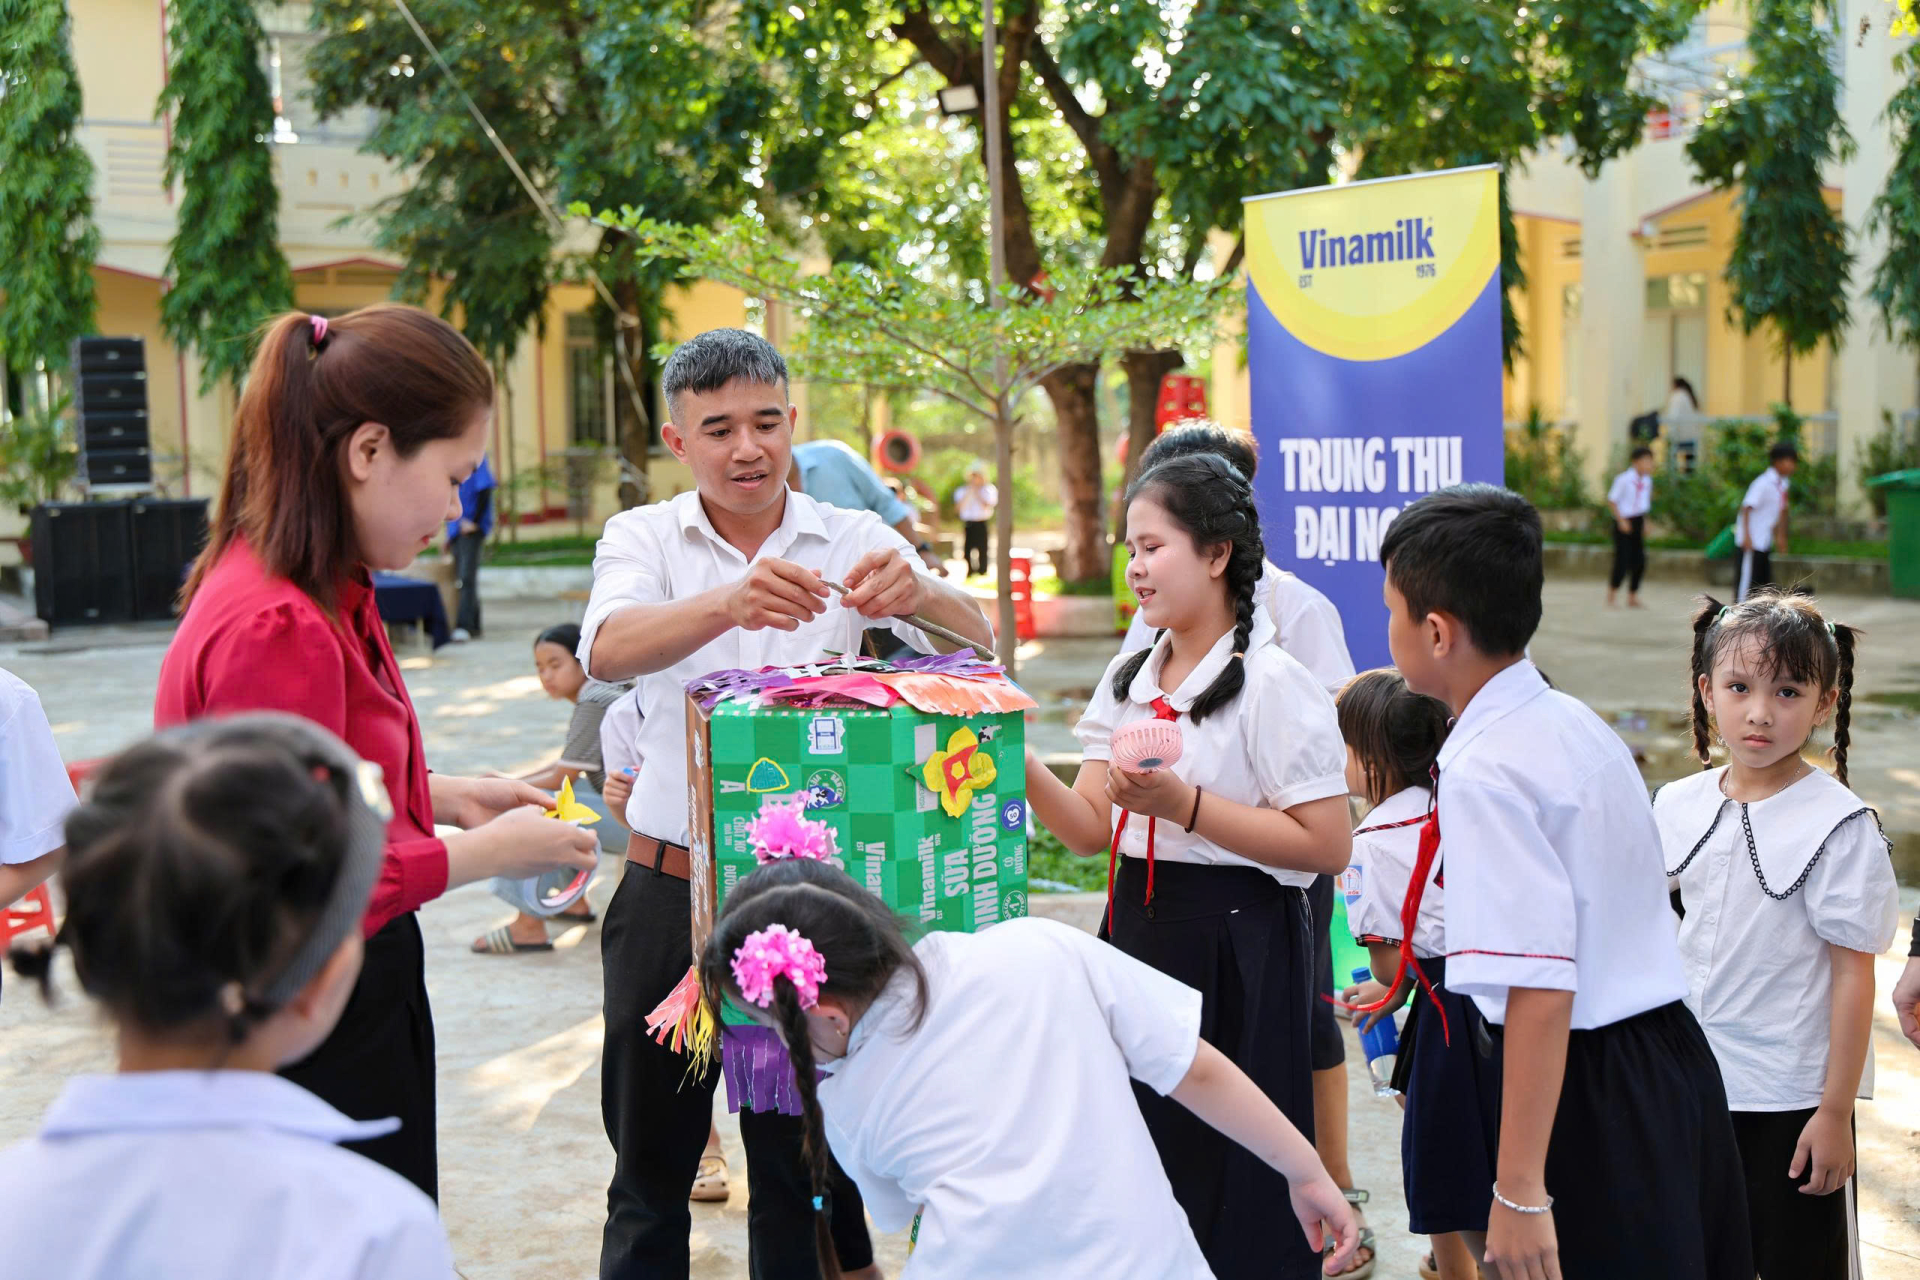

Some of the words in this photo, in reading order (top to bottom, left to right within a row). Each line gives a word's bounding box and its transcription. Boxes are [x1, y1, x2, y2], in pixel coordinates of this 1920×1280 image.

[1299, 217, 1435, 270] Vinamilk
[1279, 437, 1386, 493] TRUNG
[1391, 436, 1463, 493] THU
[1294, 507, 1351, 567] ĐẠI
[968, 793, 1000, 878] DƯỠNG
[917, 834, 937, 924] Vinamilk
[940, 848, 970, 898] SỮA
